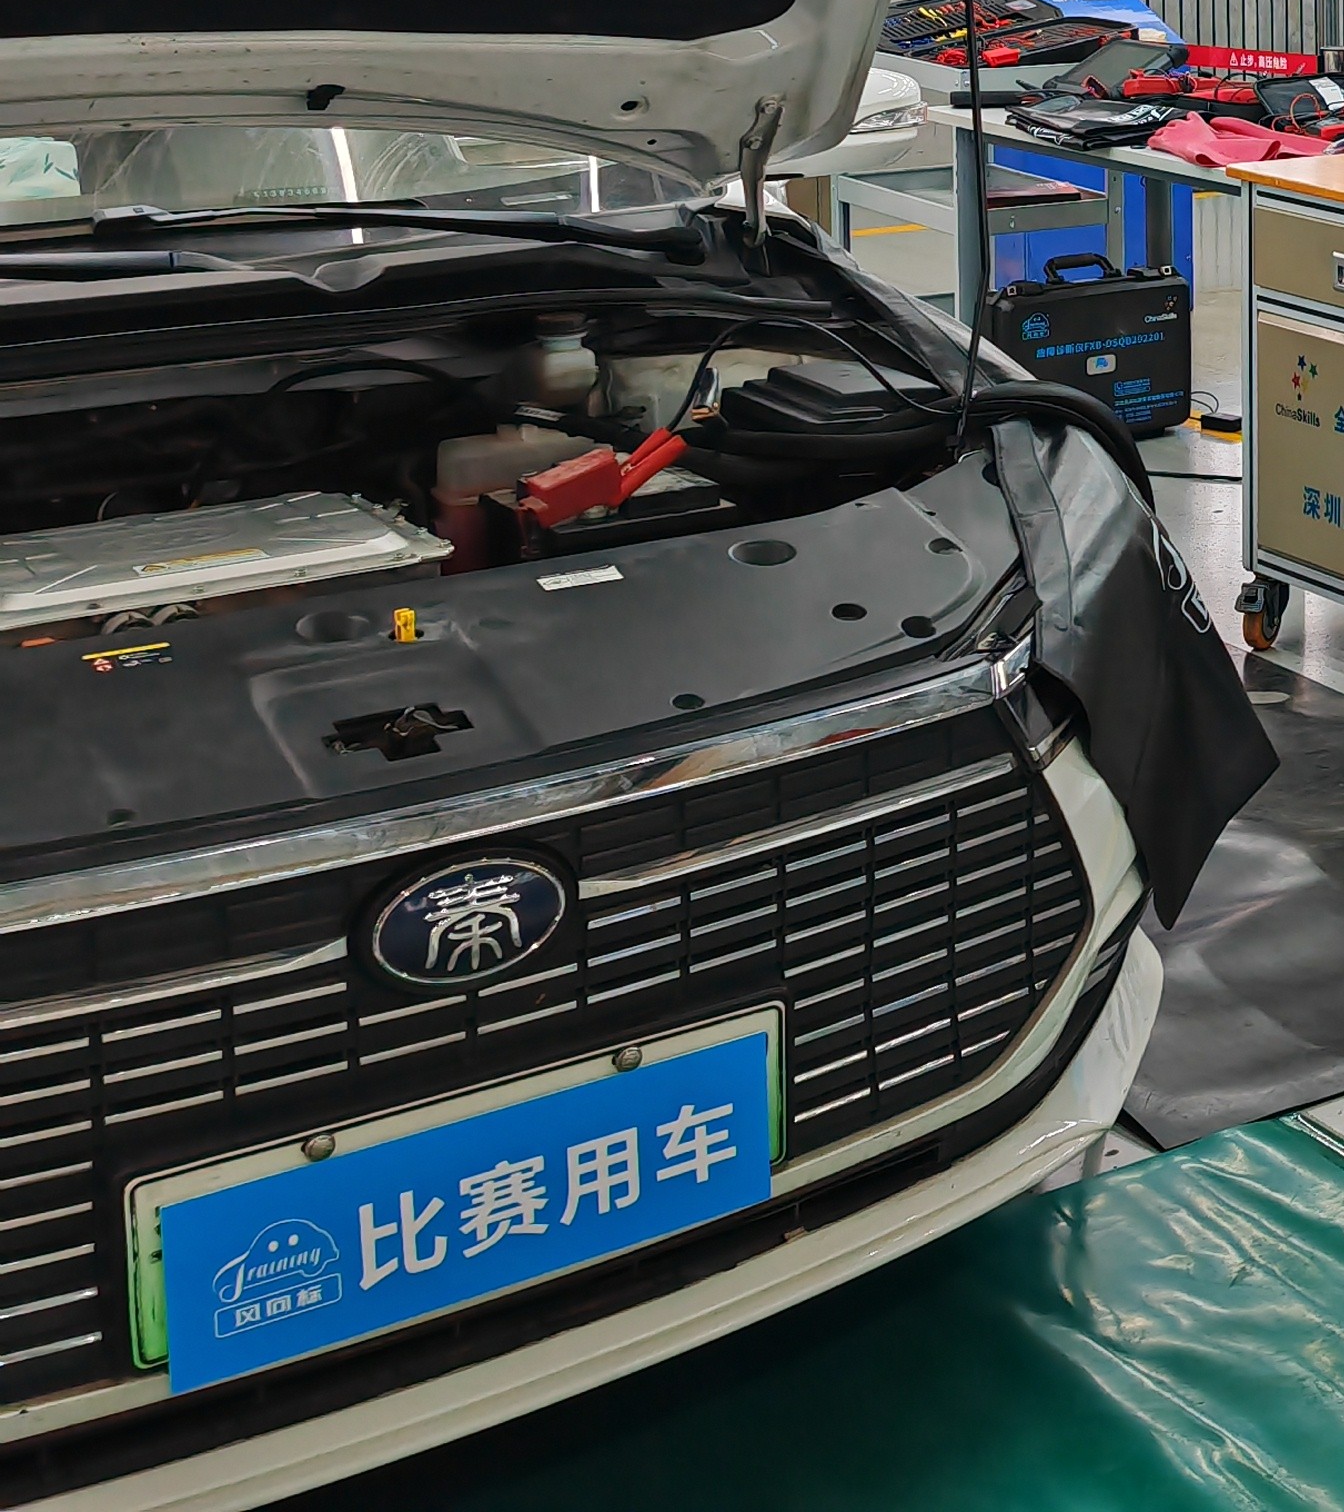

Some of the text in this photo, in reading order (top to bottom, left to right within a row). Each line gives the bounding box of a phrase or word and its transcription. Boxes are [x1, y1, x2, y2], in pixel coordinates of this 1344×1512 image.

[1275, 402, 1321, 428] ChinaSkills
[357, 1101, 738, 1292] 比赛用车
[233, 1281, 324, 1329] 风向标
